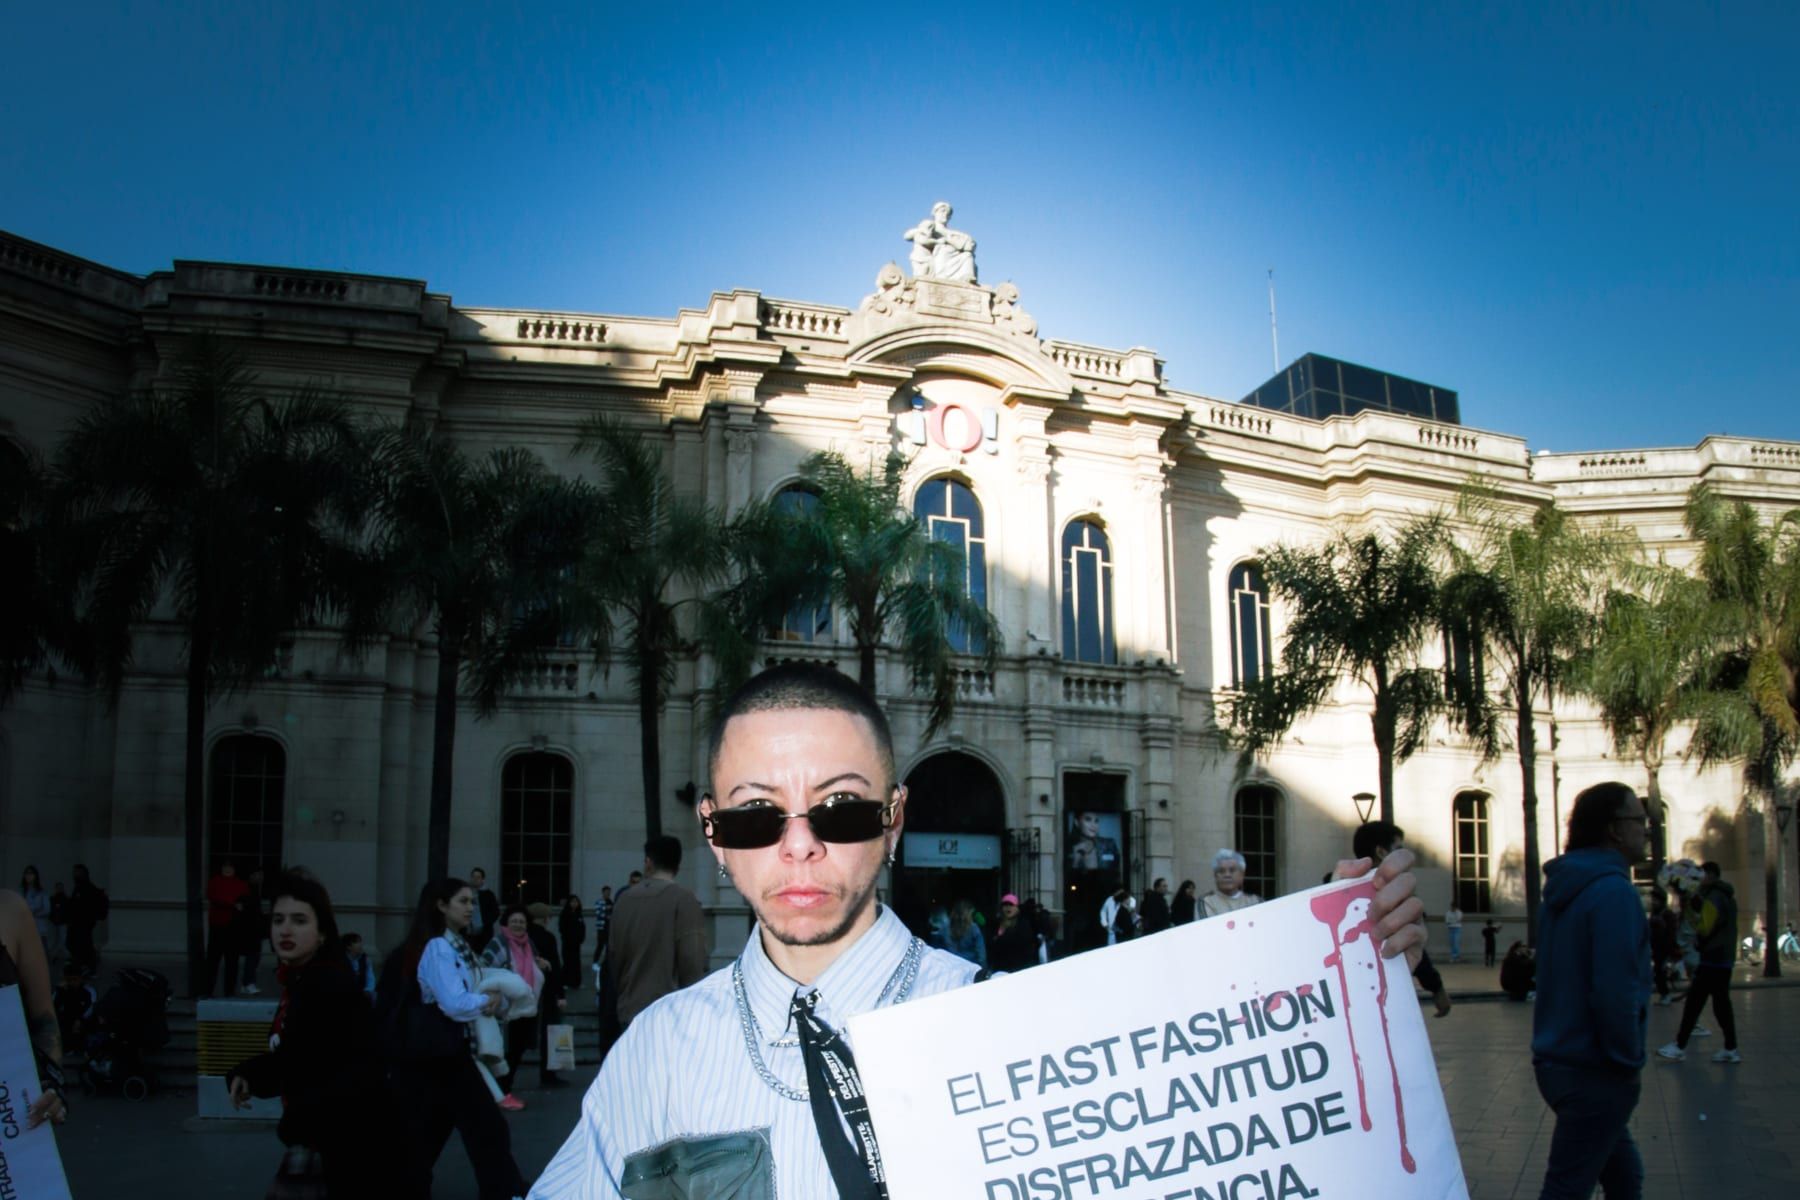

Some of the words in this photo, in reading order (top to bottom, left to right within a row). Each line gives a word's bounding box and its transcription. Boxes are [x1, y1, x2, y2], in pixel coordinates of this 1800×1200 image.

[946, 1071, 1006, 1116] EL
[1006, 1036, 1121, 1101] FAST
[1129, 979, 1336, 1069] FASHION
[977, 1116, 1040, 1164] ES
[1043, 1041, 1329, 1149] ESCLAVITUD
[1282, 1091, 1352, 1145] DE
